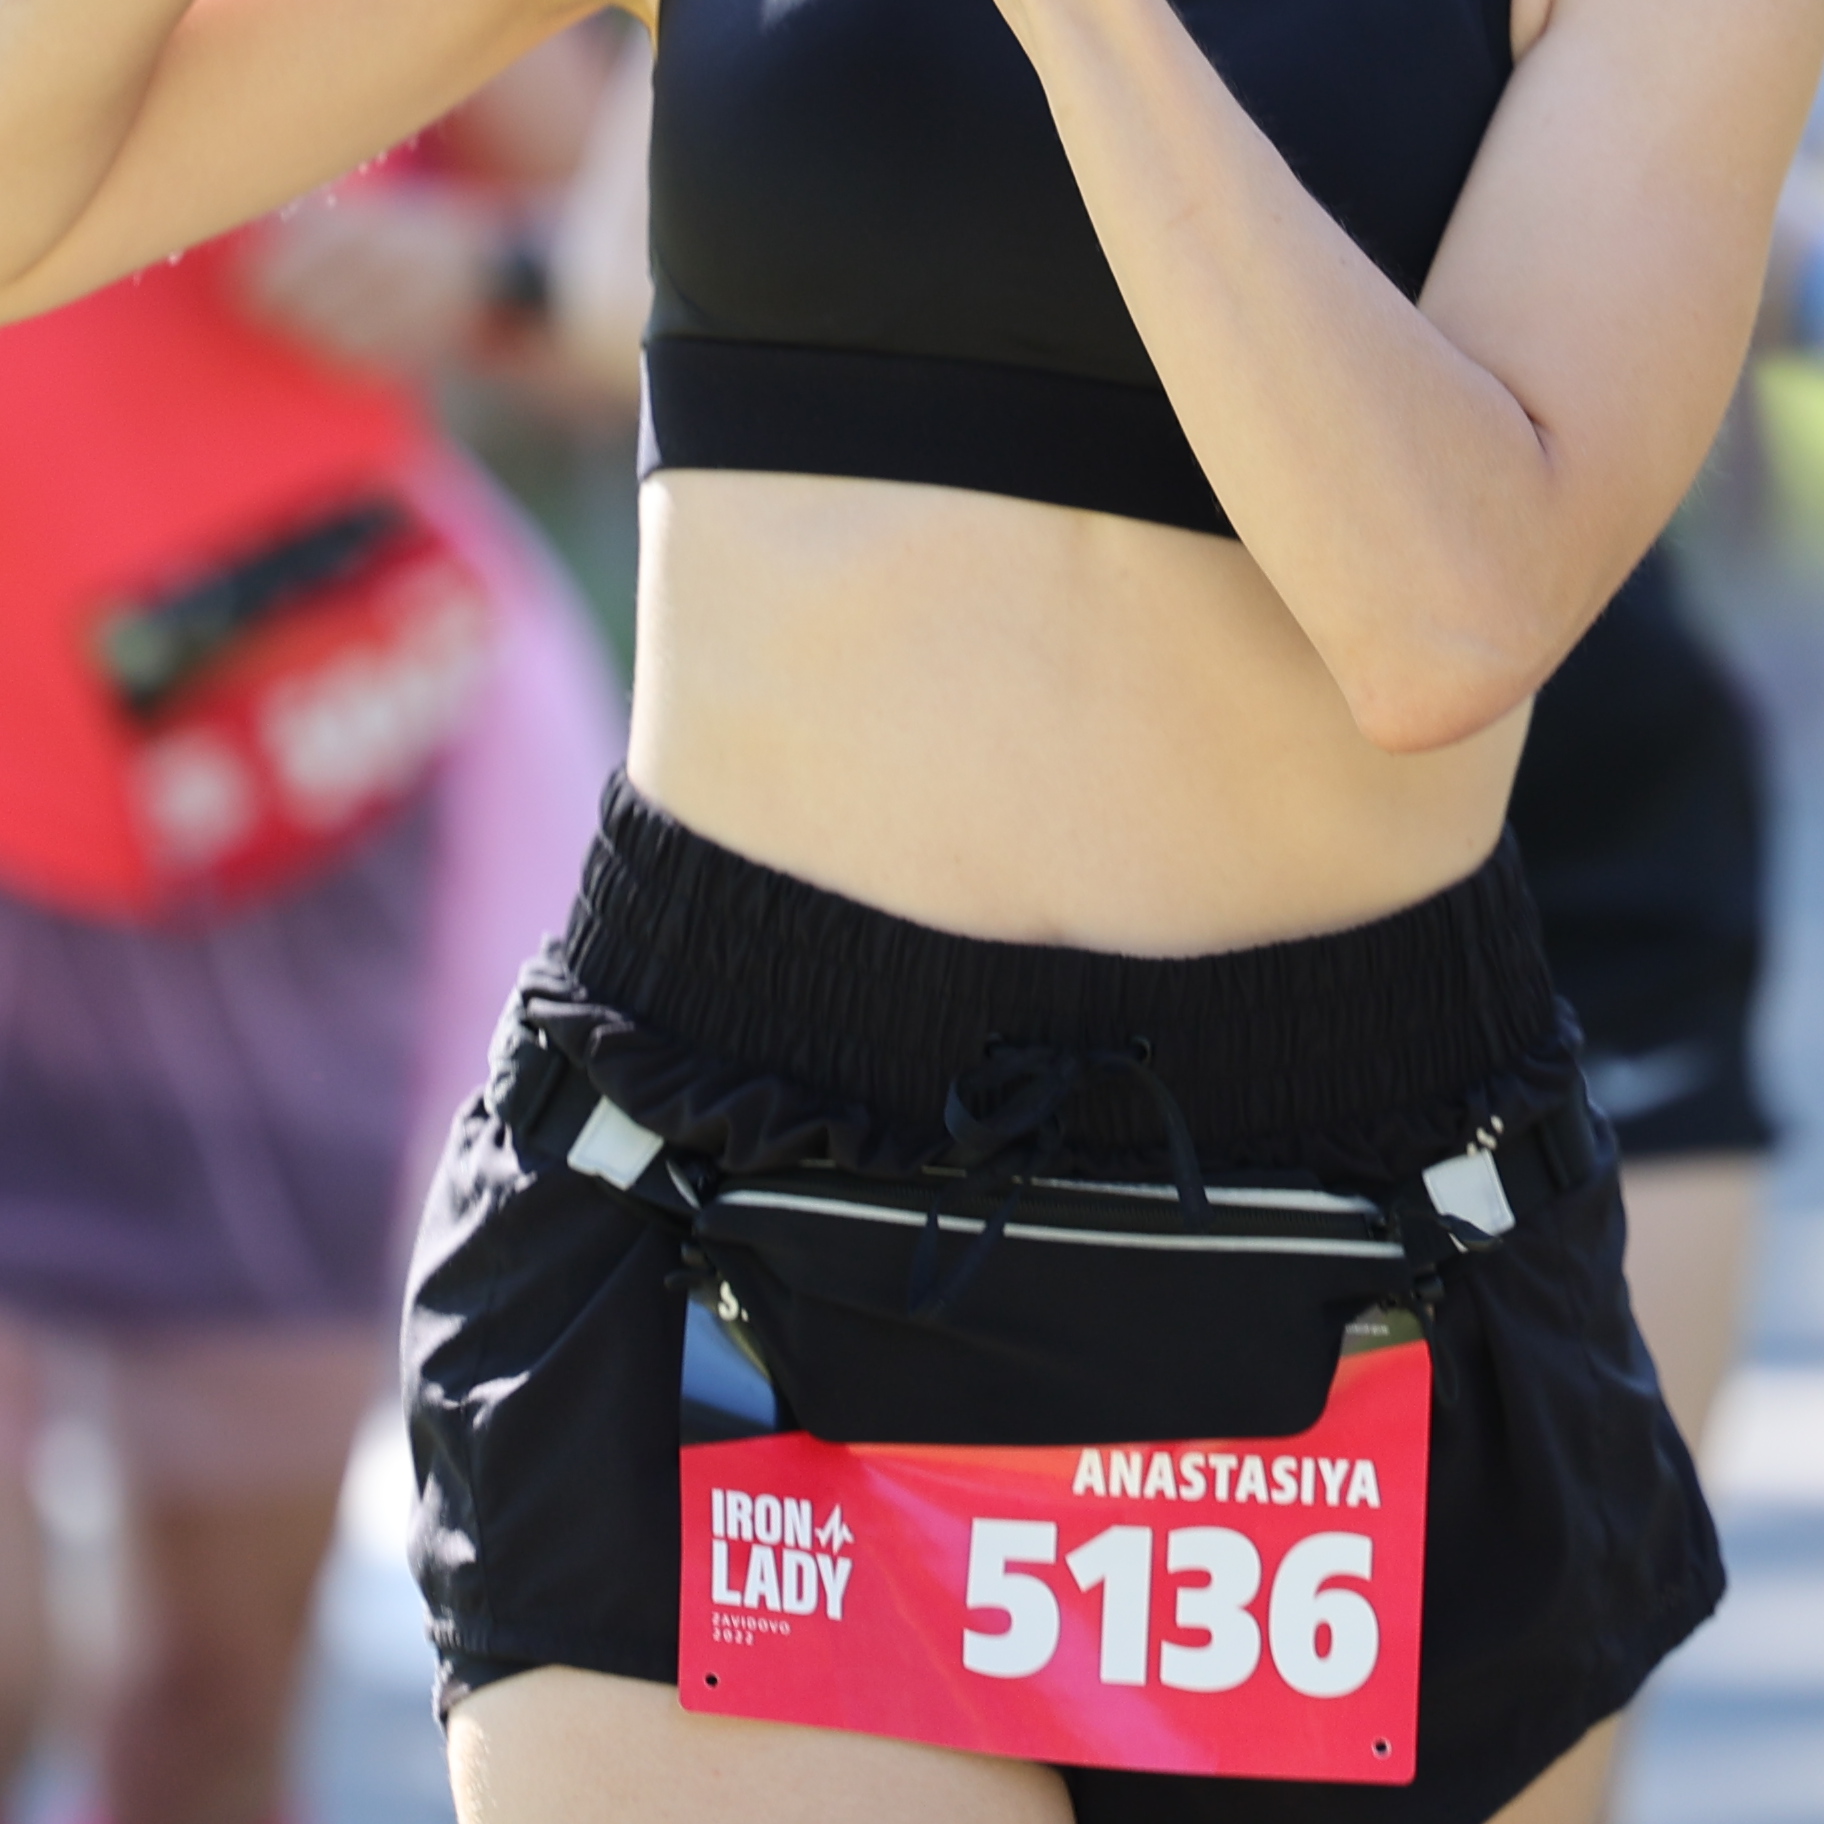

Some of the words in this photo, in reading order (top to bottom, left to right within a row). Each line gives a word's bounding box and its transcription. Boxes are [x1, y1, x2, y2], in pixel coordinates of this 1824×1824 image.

[1072, 1448, 1381, 1508] ANASTASIYA
[710, 1487, 813, 1551] IRON
[710, 1537, 854, 1622] LADY
[962, 1517, 1380, 1700] 5136
[711, 1610, 792, 1637] ZAVIDOVO
[712, 1626, 755, 1647] 2022
